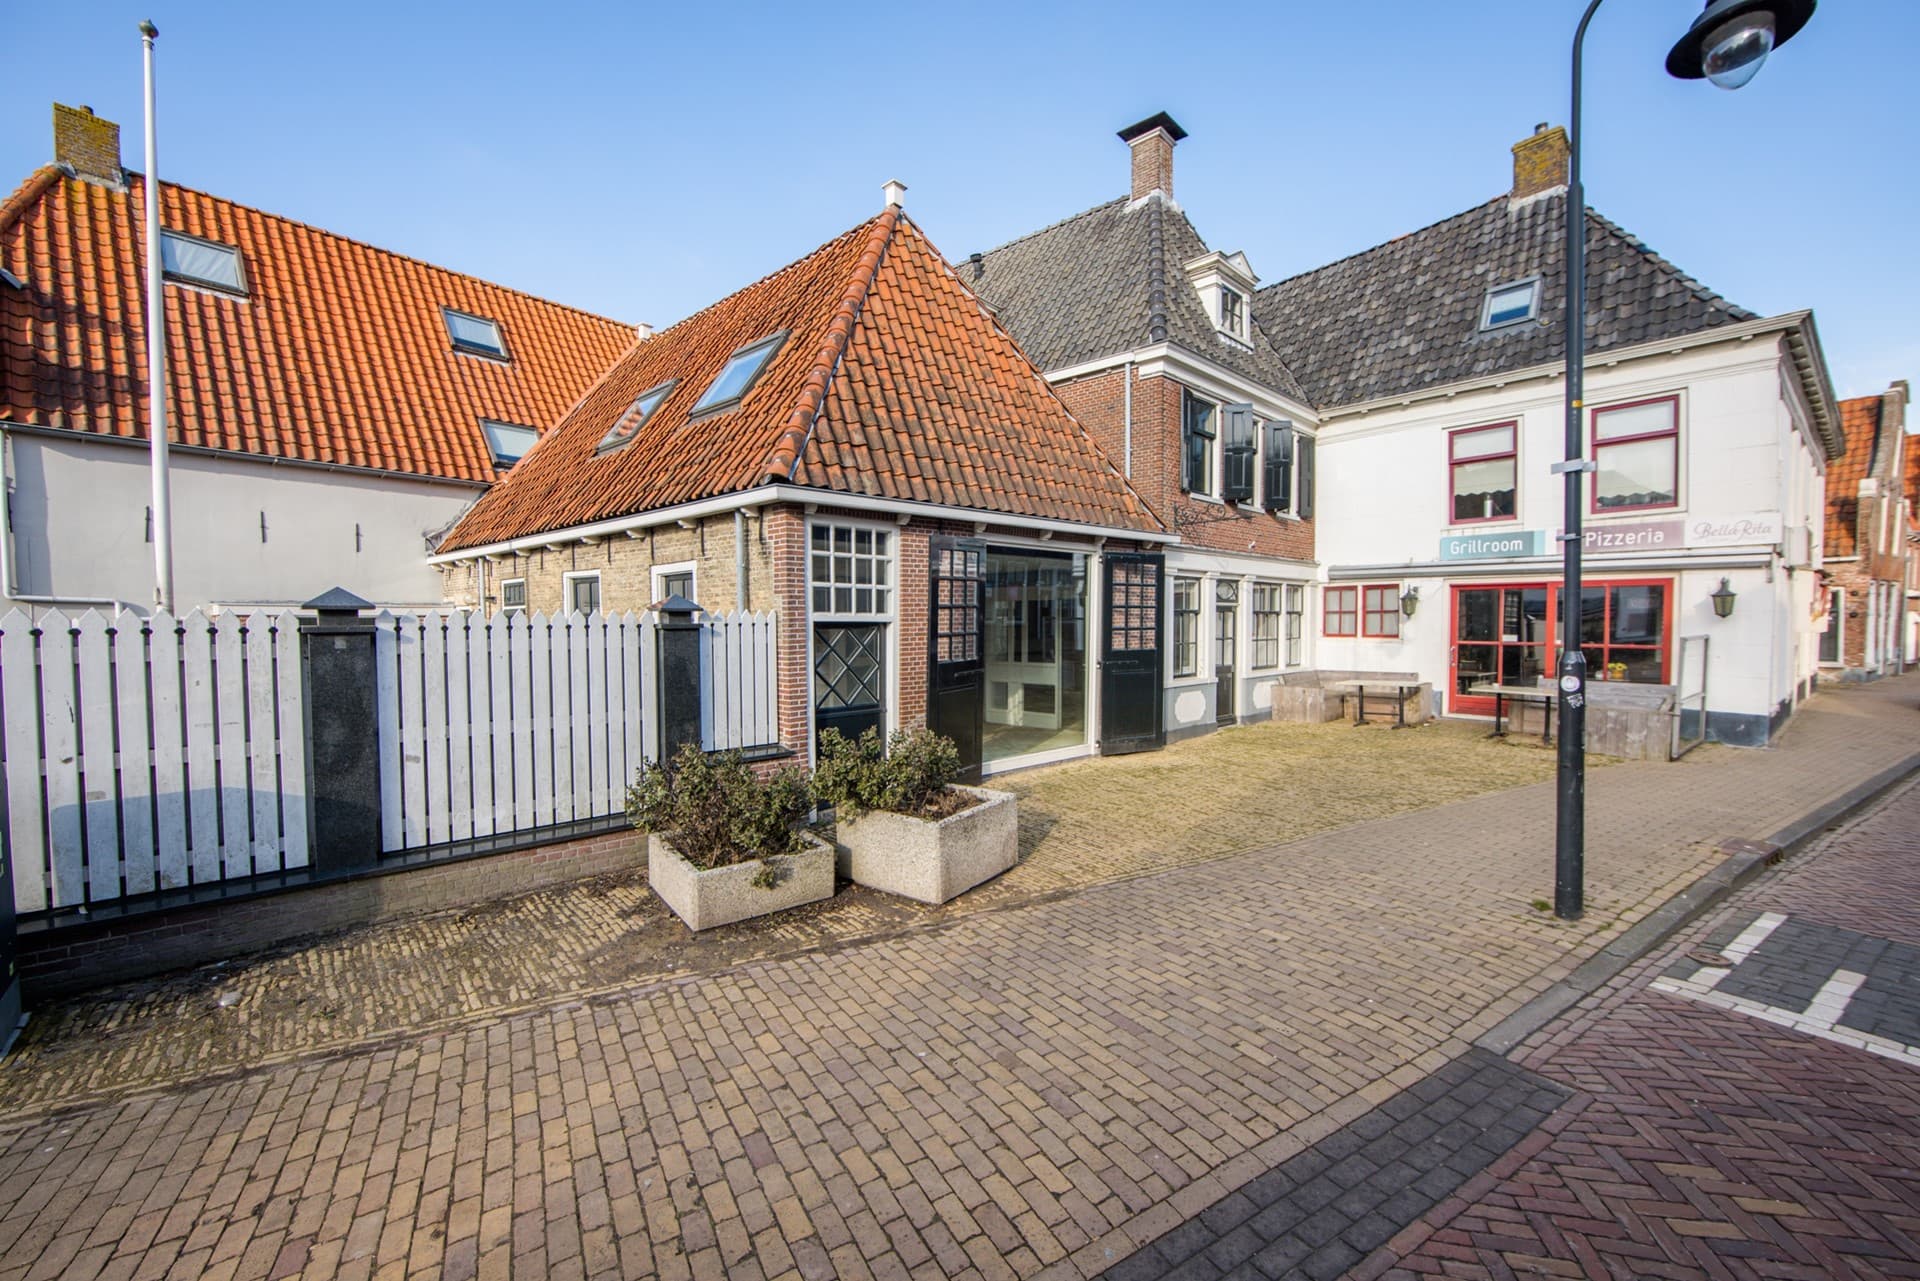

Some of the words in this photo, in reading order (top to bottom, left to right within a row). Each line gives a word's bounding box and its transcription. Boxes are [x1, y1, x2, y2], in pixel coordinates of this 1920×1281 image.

[1585, 528, 1665, 547] Pizzeria
[1694, 521, 1738, 539] Bella
[1736, 519, 1773, 541] Rita
[1450, 539, 1524, 554] Grillroom
